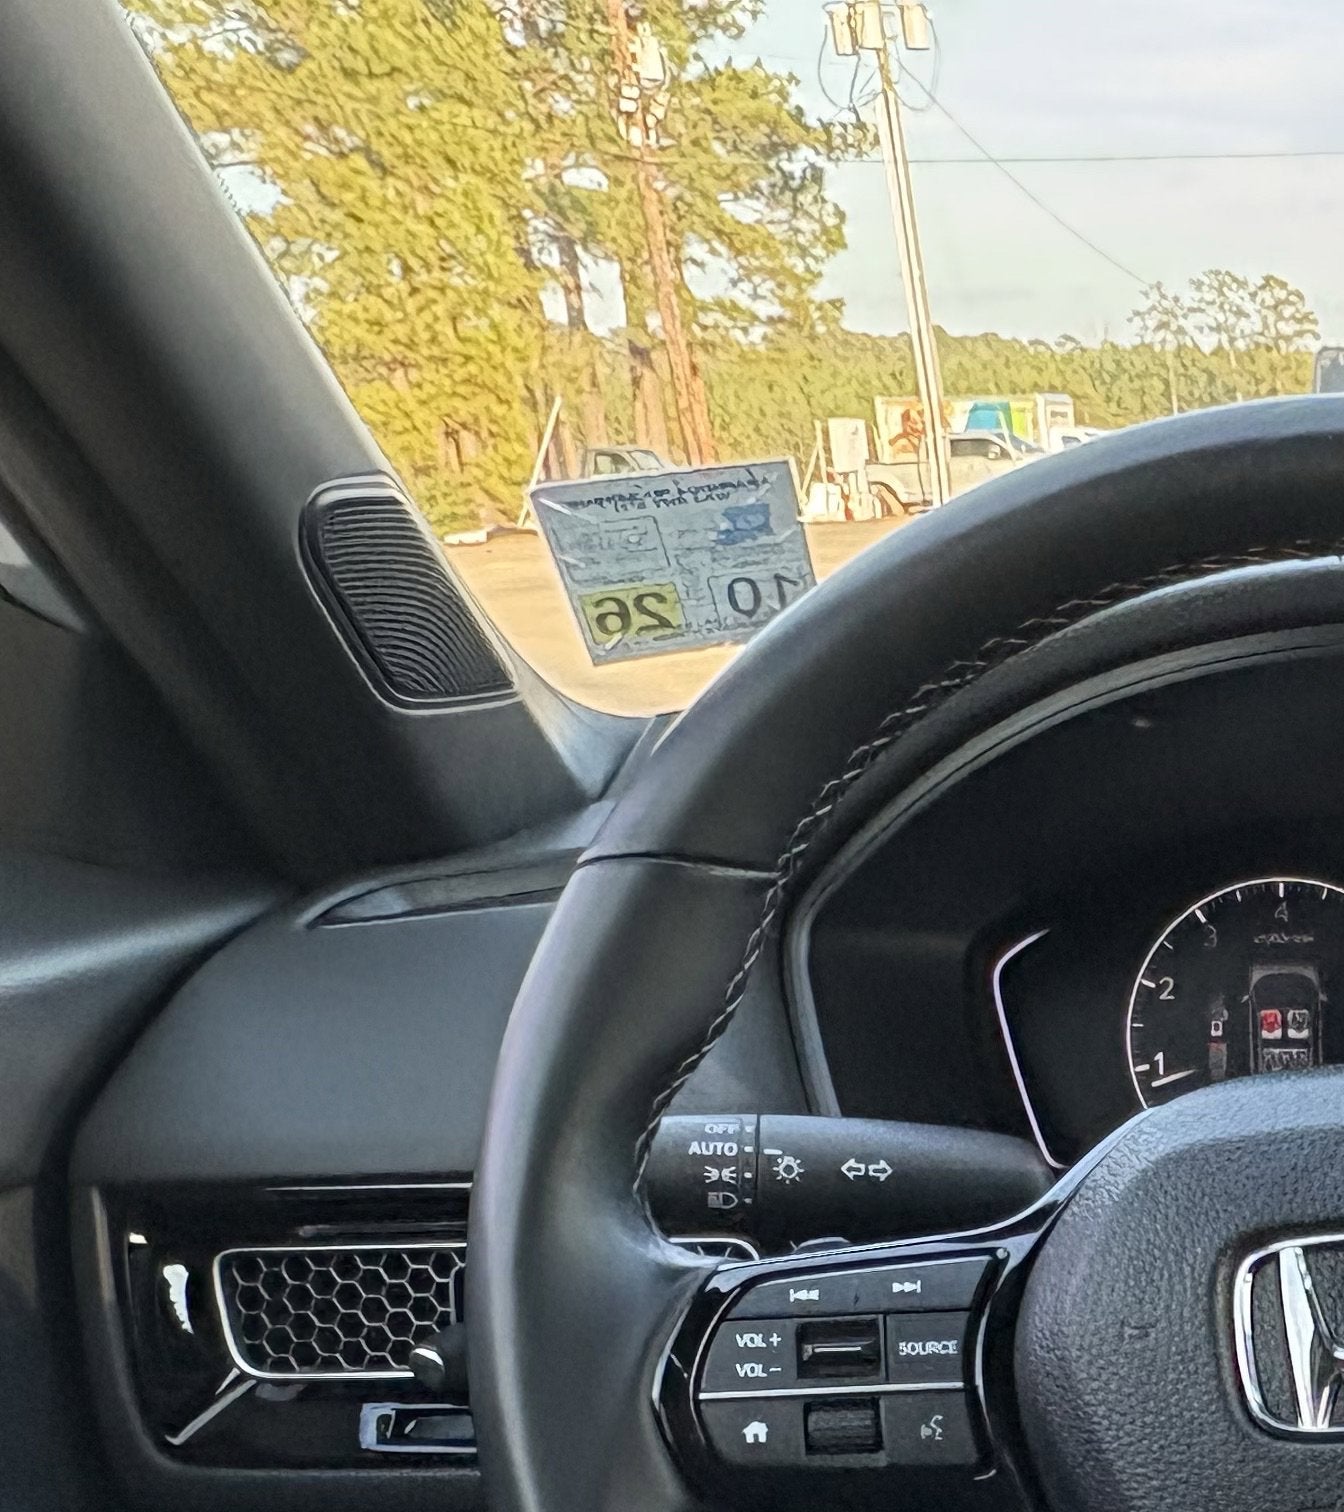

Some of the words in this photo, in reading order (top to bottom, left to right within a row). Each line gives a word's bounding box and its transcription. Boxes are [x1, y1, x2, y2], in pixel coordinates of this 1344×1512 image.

[1203, 926, 1218, 947] 3
[1159, 978, 1176, 1000] 2
[1152, 1051, 1165, 1075] 1
[688, 1141, 738, 1156] AUTO
[898, 1340, 958, 1356] SOURCE
